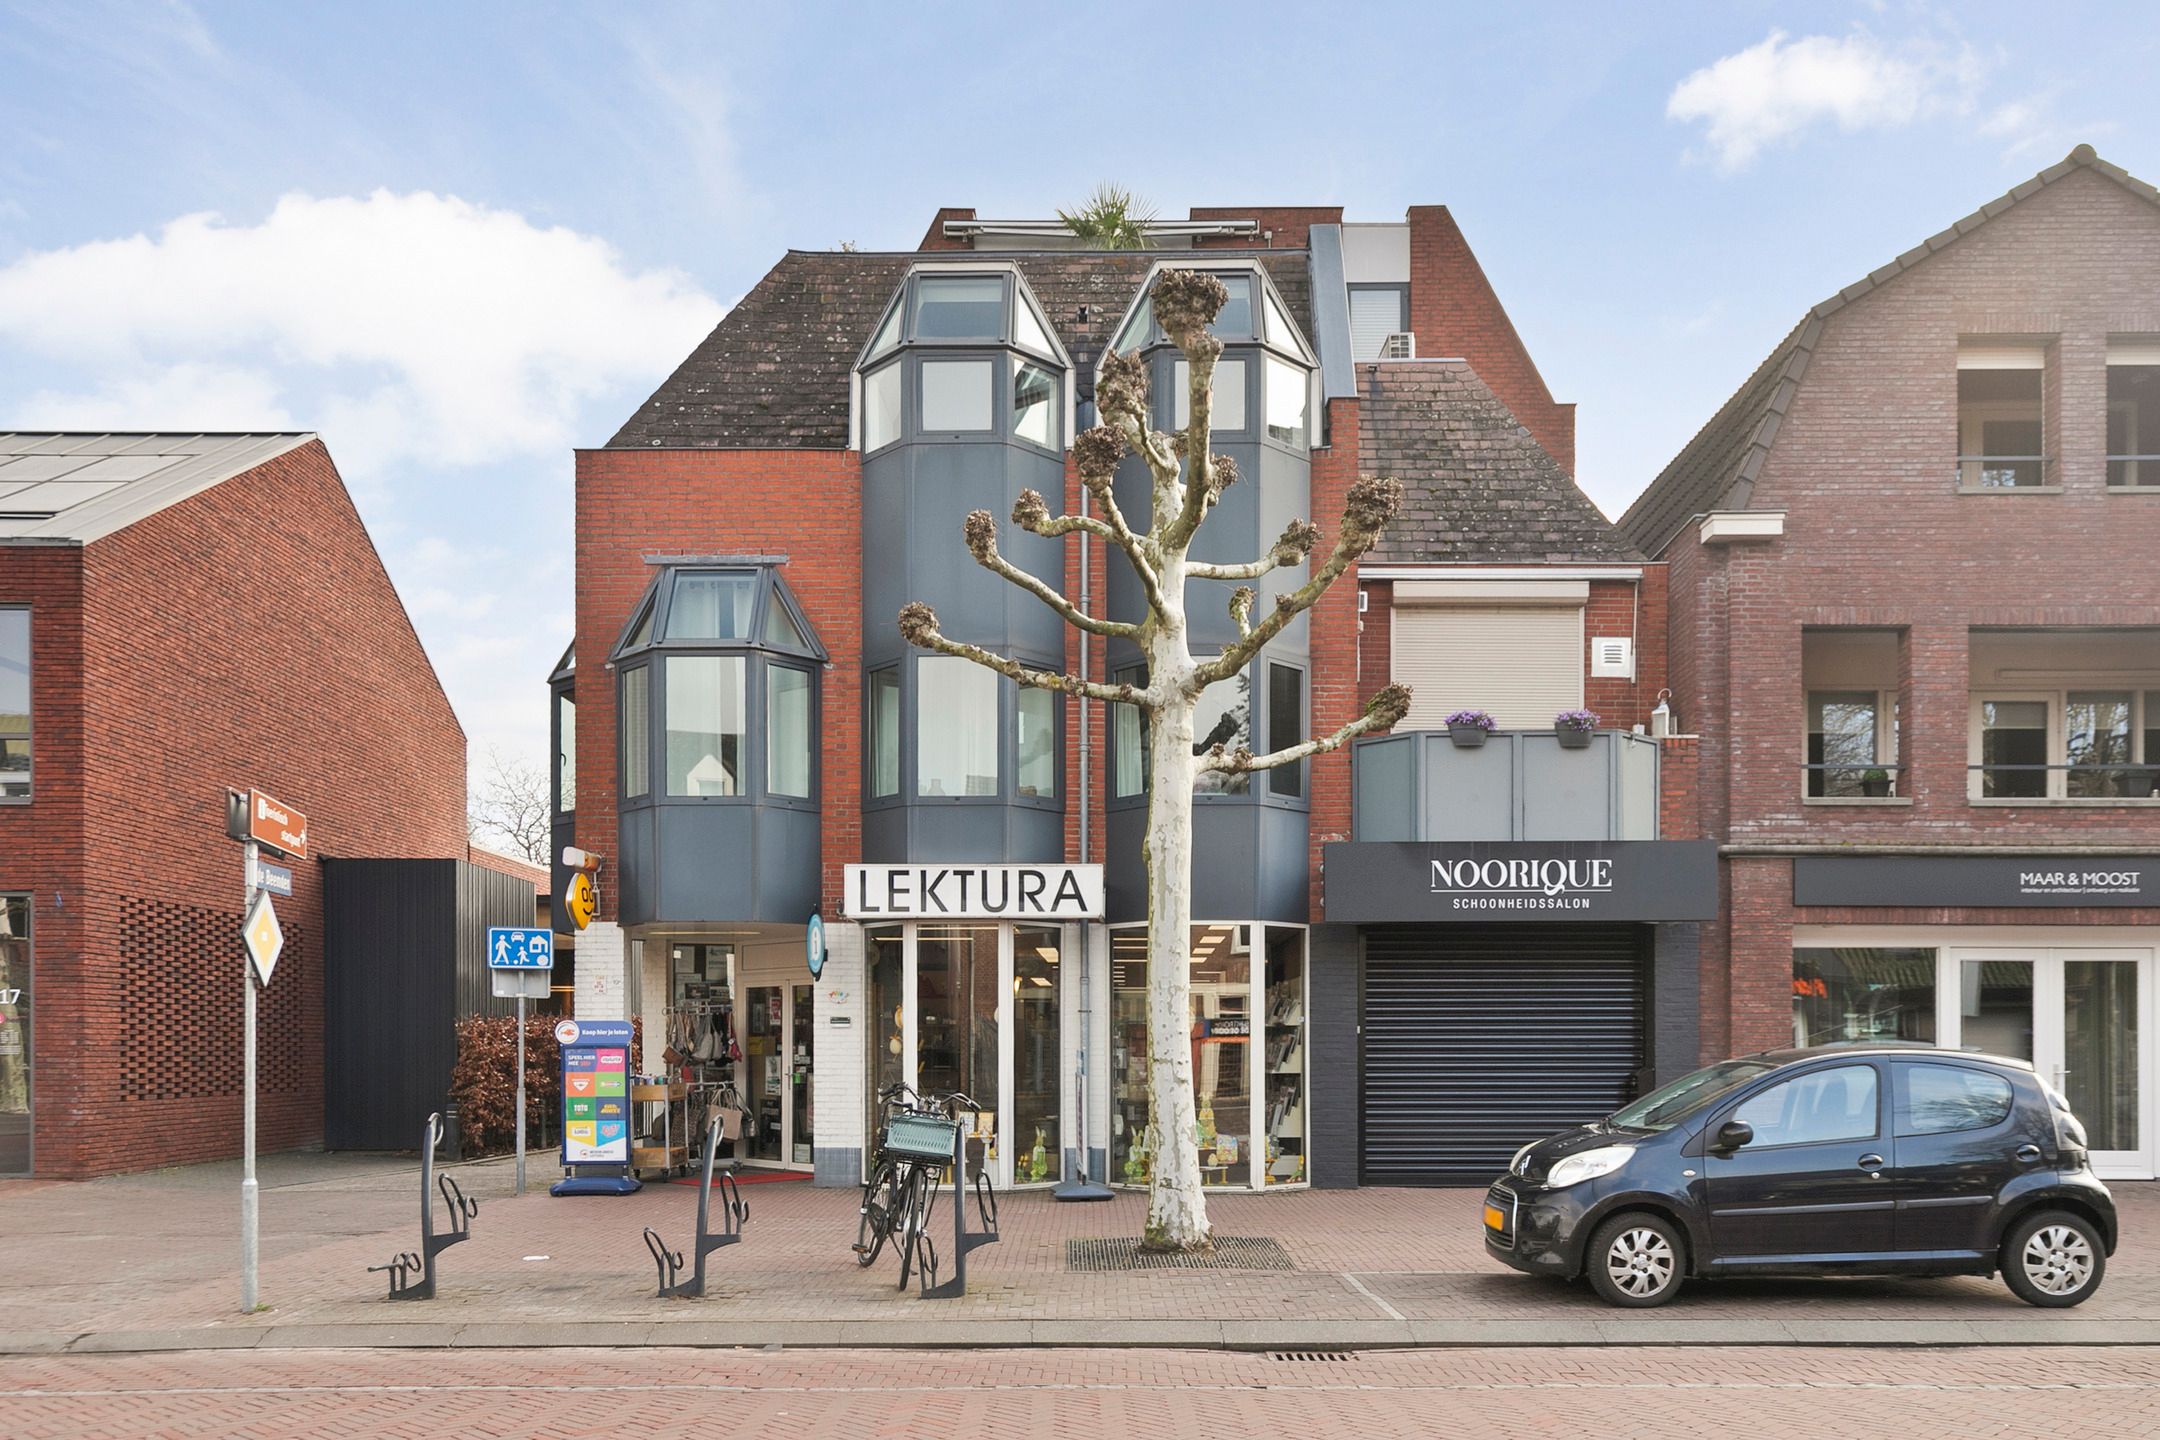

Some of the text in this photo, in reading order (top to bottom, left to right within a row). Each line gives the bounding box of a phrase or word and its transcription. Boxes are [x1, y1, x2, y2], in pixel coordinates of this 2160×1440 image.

[1430, 859, 1613, 896] NOORIQUE
[2020, 872, 2140, 886] MAAR & MOOST
[860, 869, 1088, 913] LEKTURA
[1453, 898, 1590, 909] SCHOONHEIDSSALON
